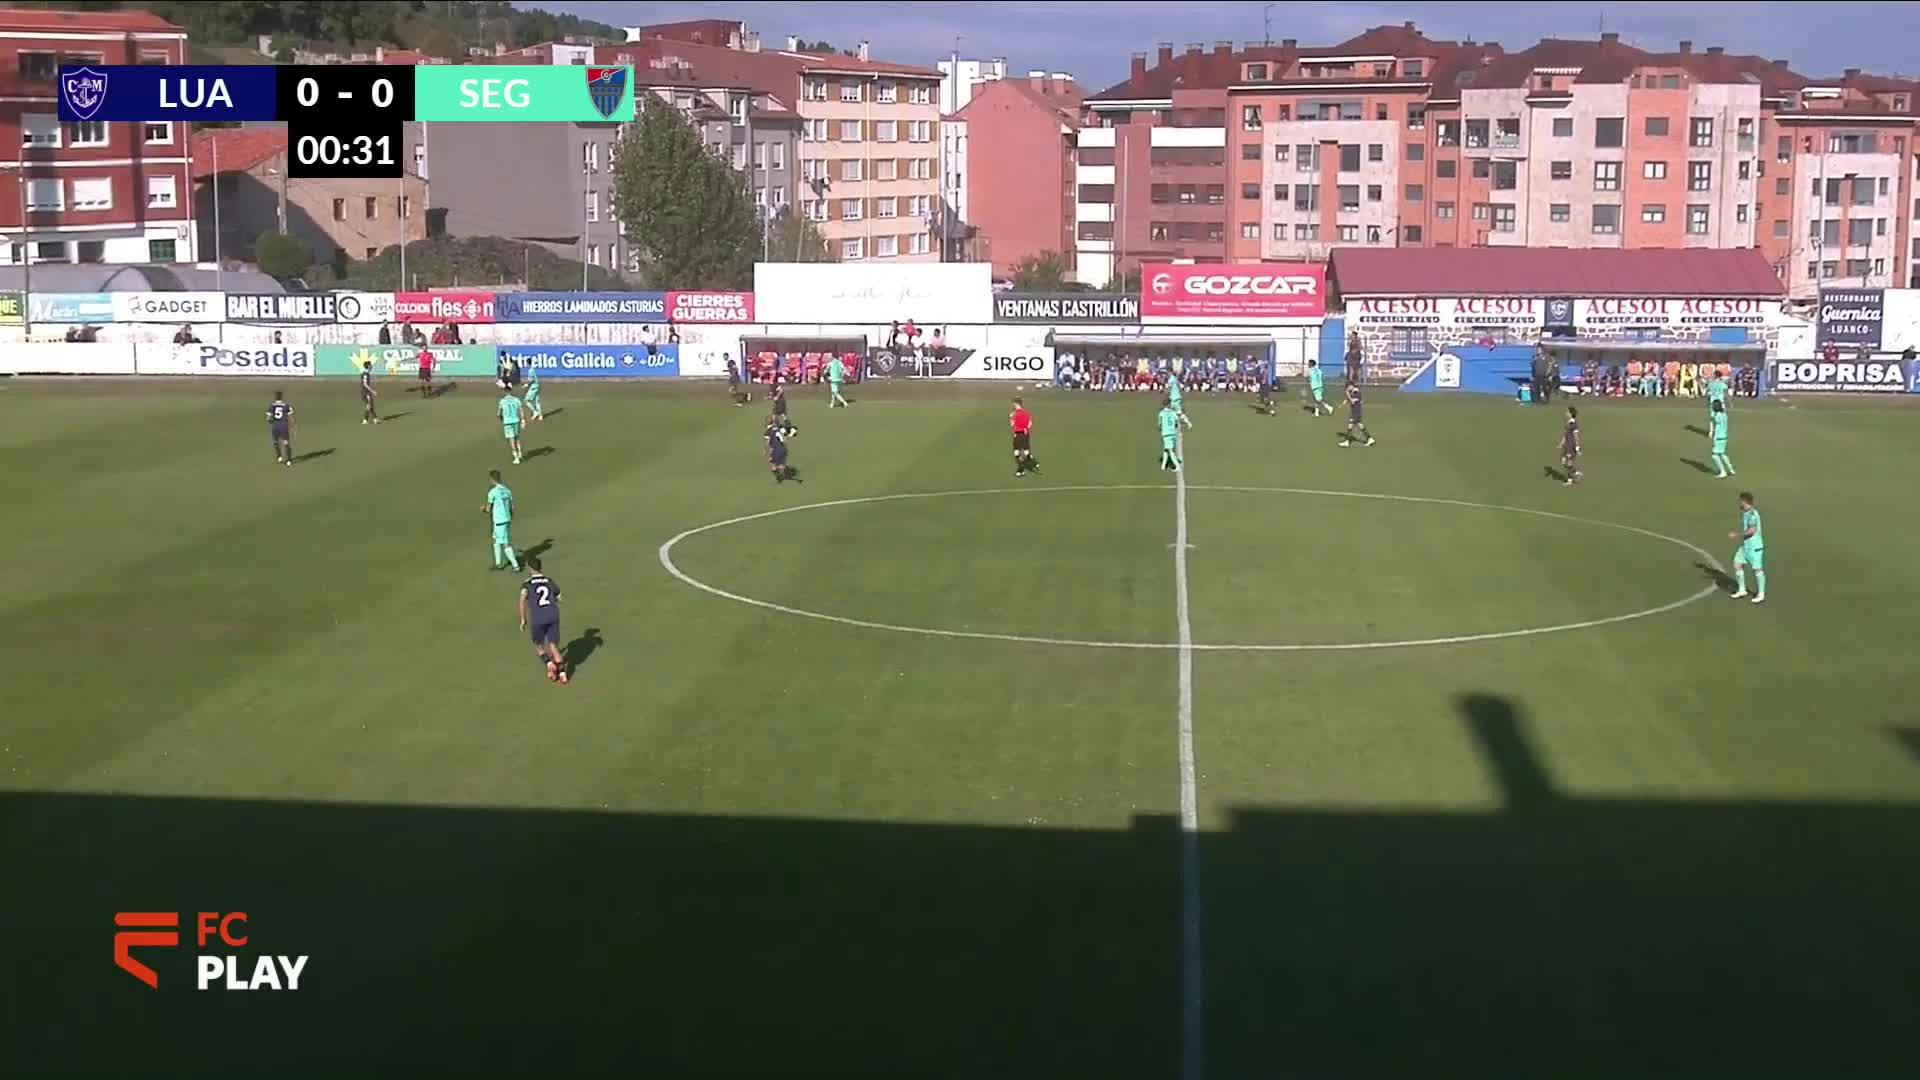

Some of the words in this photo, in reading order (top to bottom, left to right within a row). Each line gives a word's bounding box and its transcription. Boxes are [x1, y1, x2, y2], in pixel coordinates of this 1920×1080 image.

[1184, 275, 1318, 295] GOZCAR
[145, 299, 208, 313] GADGET
[227, 296, 259, 319] BAR
[260, 296, 277, 319] EL
[278, 296, 335, 319] MUELLE
[522, 300, 564, 313] HIERROS
[565, 300, 618, 313] LAMINADOS
[618, 300, 664, 313] ASTURIAS
[676, 295, 745, 308] CIERRES
[997, 299, 1059, 318] VENTANAS
[1062, 297, 1138, 318] CASTRILLÓN
[1360, 298, 1440, 314] ACESOL
[1454, 298, 1536, 314] ACESOL
[1586, 299, 1669, 314] ACESOL
[1680, 299, 1764, 314] ACESOL
[672, 307, 748, 320] GUERRAS
[1821, 304, 1881, 323] Guernica
[200, 346, 308, 367] Posada
[561, 352, 615, 368] Galicia
[983, 356, 1044, 371] SIRGO
[1777, 362, 1905, 382] BOPRISA
[274, 407, 283, 419] 5
[536, 586, 550, 606] 2
